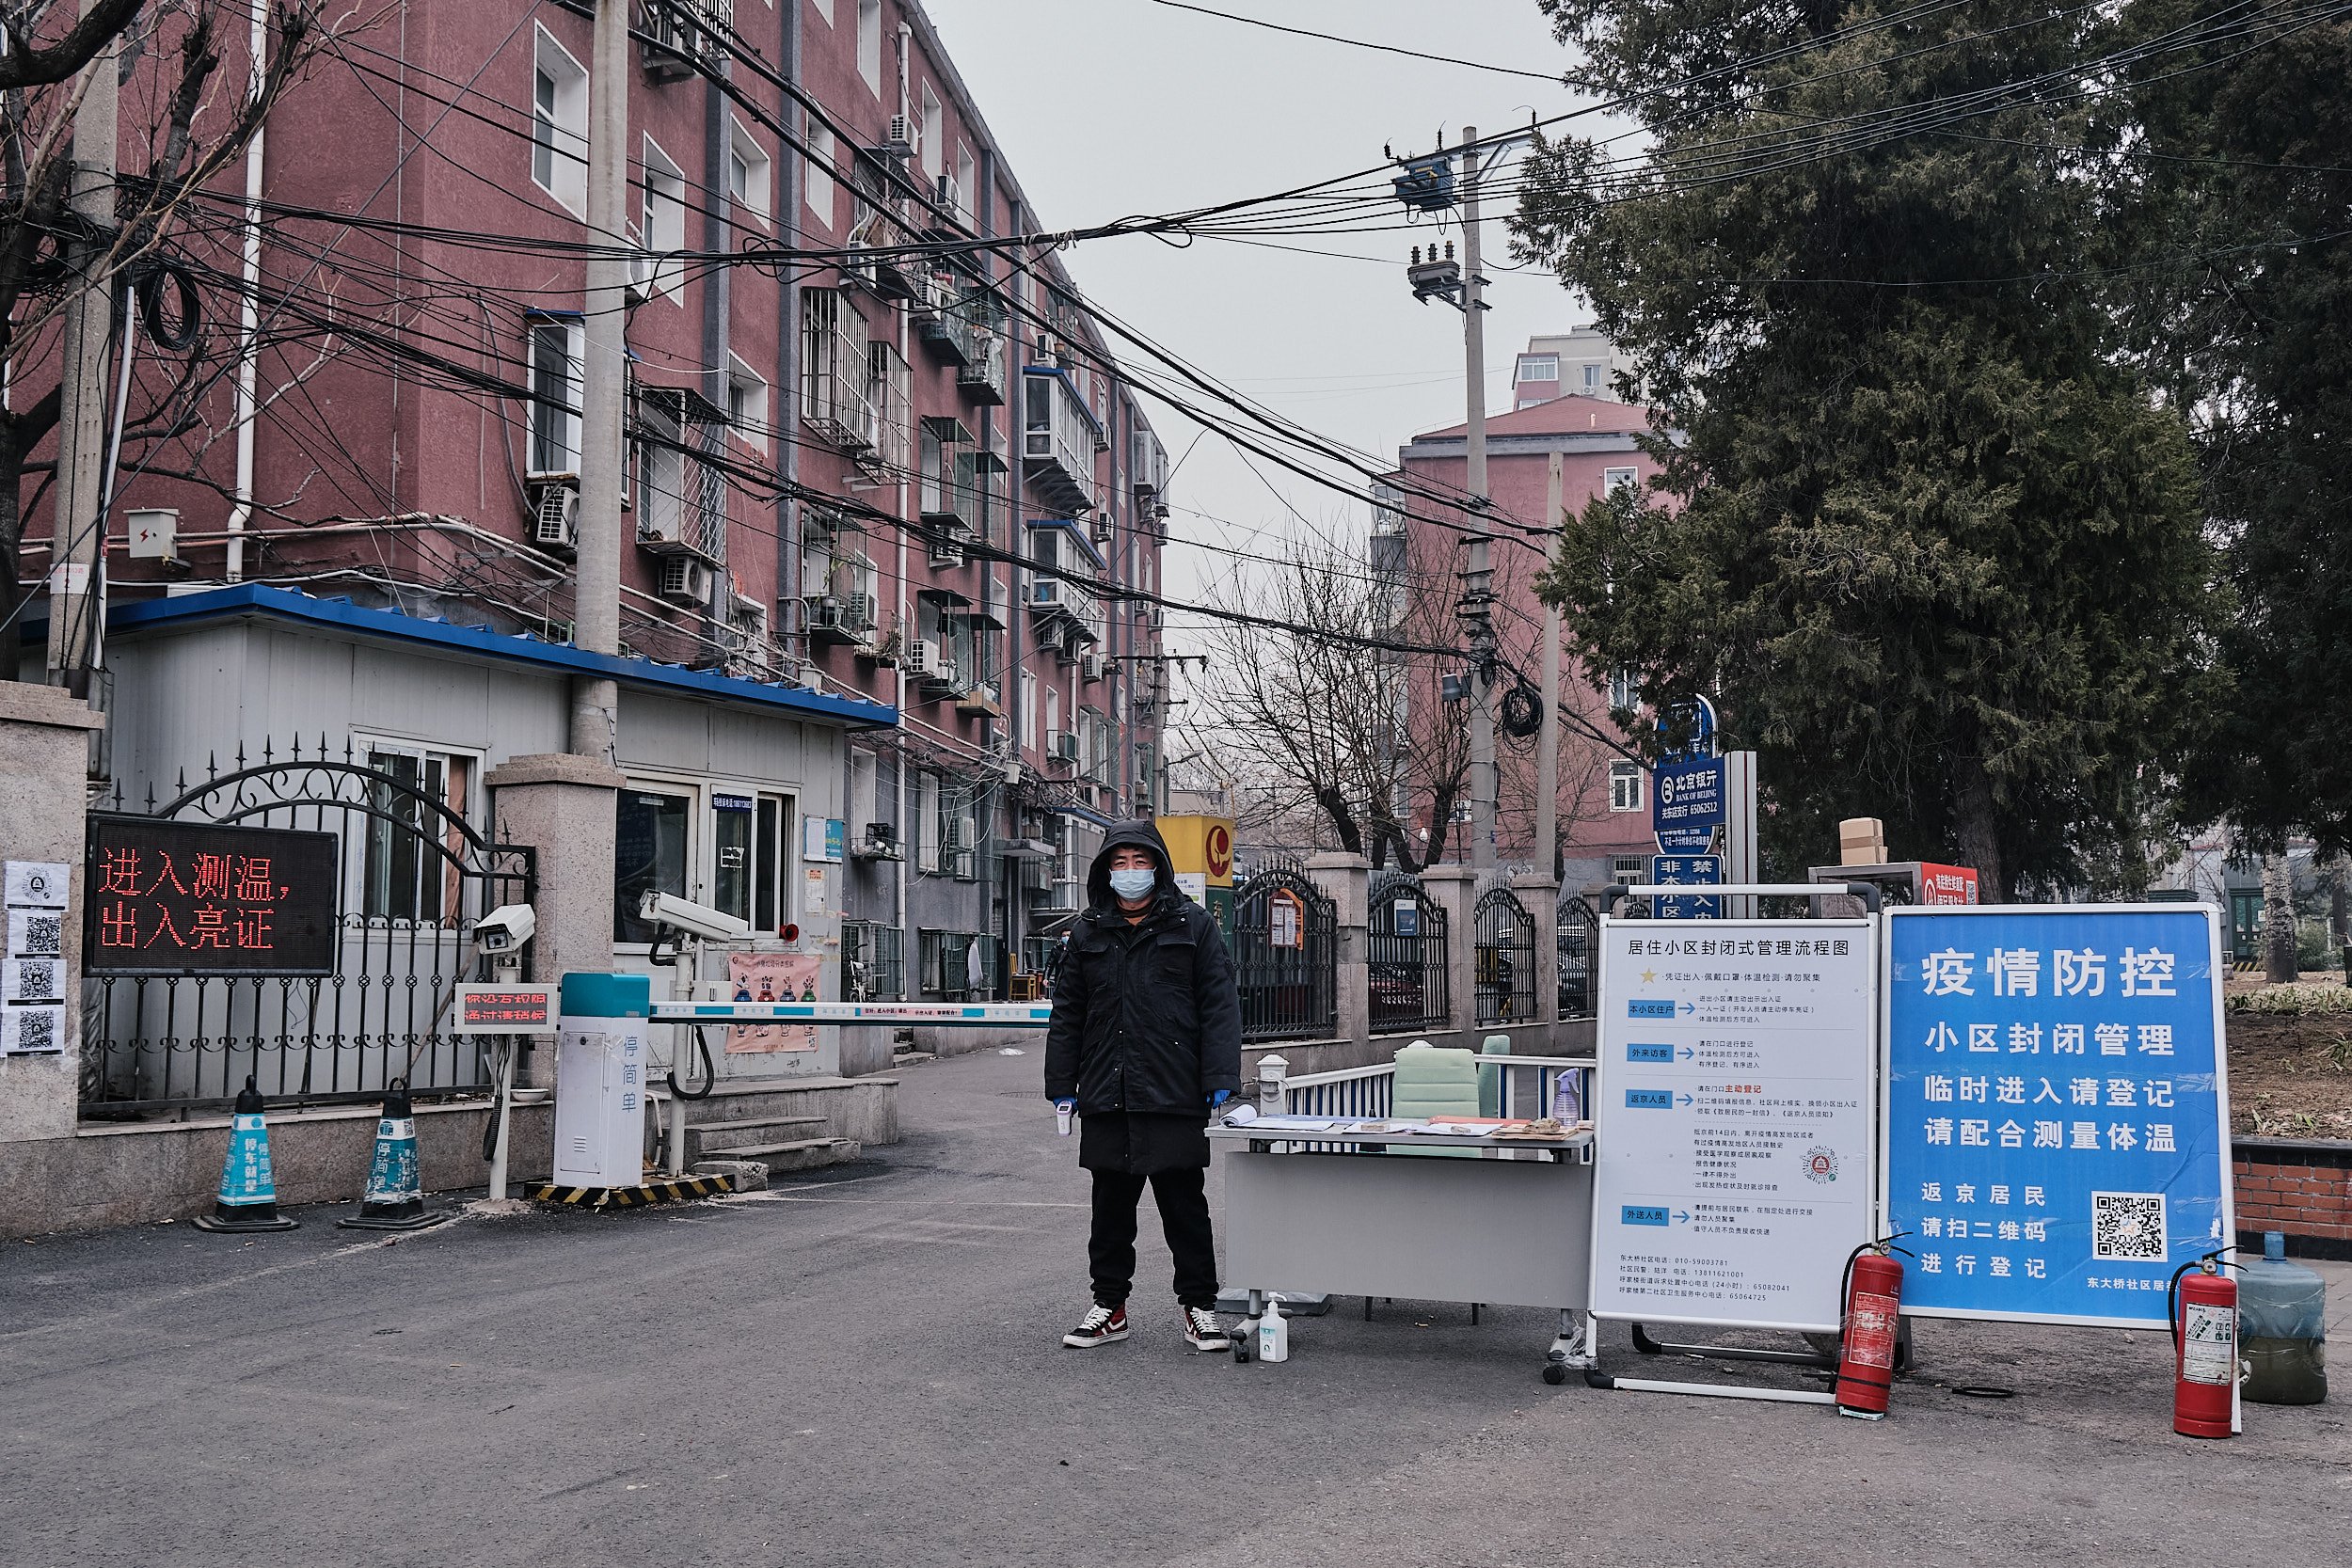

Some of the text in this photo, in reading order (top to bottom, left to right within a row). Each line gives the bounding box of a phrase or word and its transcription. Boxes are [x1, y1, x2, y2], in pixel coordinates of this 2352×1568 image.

[1676, 769, 1718, 791] 北京银行
[1676, 793, 1690, 802] BANK
[1690, 791, 1697, 800] OF
[1690, 801, 1718, 816] 65062512
[99, 847, 290, 901] 进入测温，
[101, 900, 277, 950] 出入亮证
[1628, 940, 1850, 956] 居住小区封闭式管理流程图
[1921, 947, 2177, 998] 疫情防控
[1629, 1004, 1674, 1015] 本小区住户
[1925, 1022, 2175, 1056] 小区封闭管理
[1631, 1048, 1668, 1058] 外来访客
[622, 1036, 638, 1113] 停简单
[1630, 1094, 1666, 1104] 返京人员
[1924, 1075, 2175, 1108] 临时进入请登记
[1924, 1117, 2176, 1152] 请配合测量体温
[245, 1137, 257, 1192] 停车就是
[1921, 1181, 2046, 1207] 返京居民
[1627, 1210, 1663, 1221] 外送人员
[1921, 1216, 2047, 1243] 请扫二维码
[1920, 1252, 2047, 1279] 进行登记
